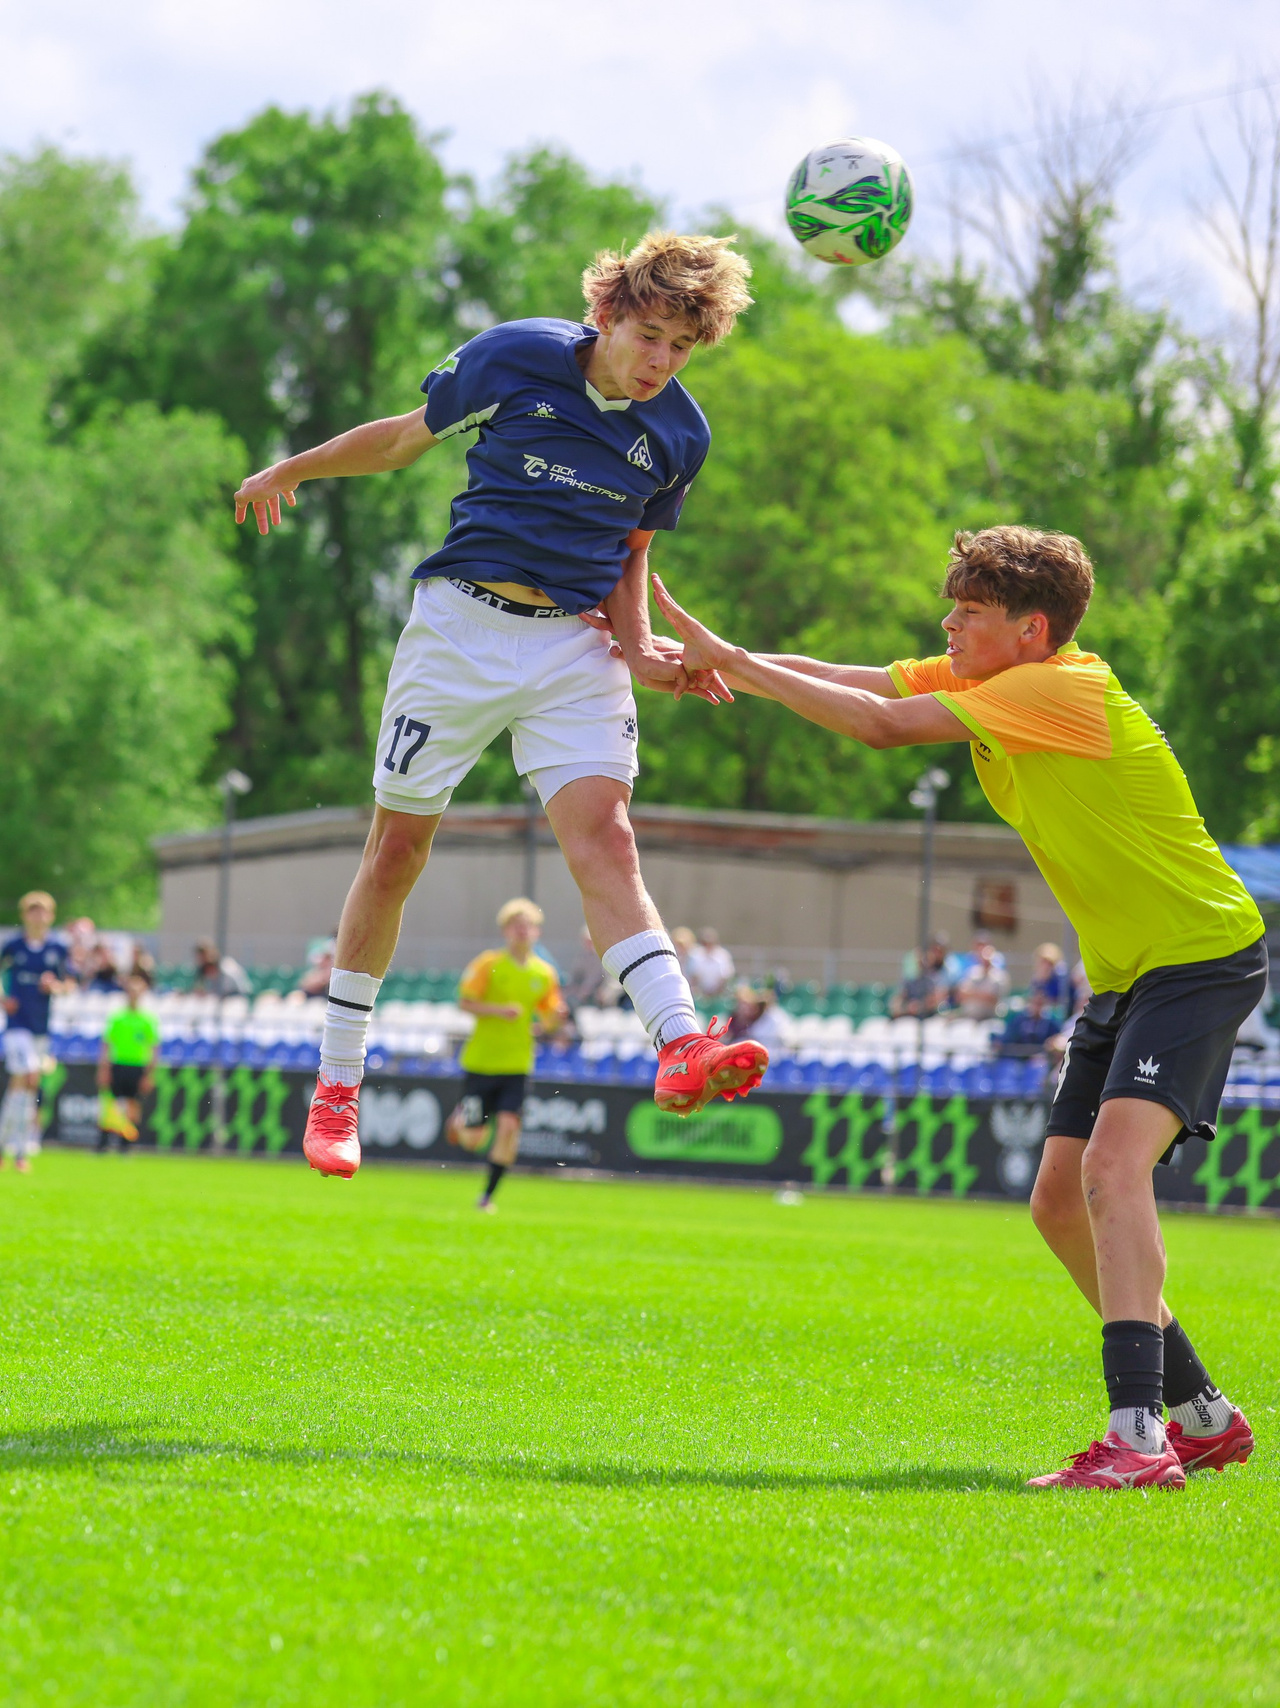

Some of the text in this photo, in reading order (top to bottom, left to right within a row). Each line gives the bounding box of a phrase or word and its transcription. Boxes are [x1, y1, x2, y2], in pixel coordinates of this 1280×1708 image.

[550, 464, 578, 477] ДСК
[548, 472, 628, 503] ТРАНССТРОЙ
[383, 714, 431, 775] 17
[1134, 1076, 1156, 1085] PRIMERA
